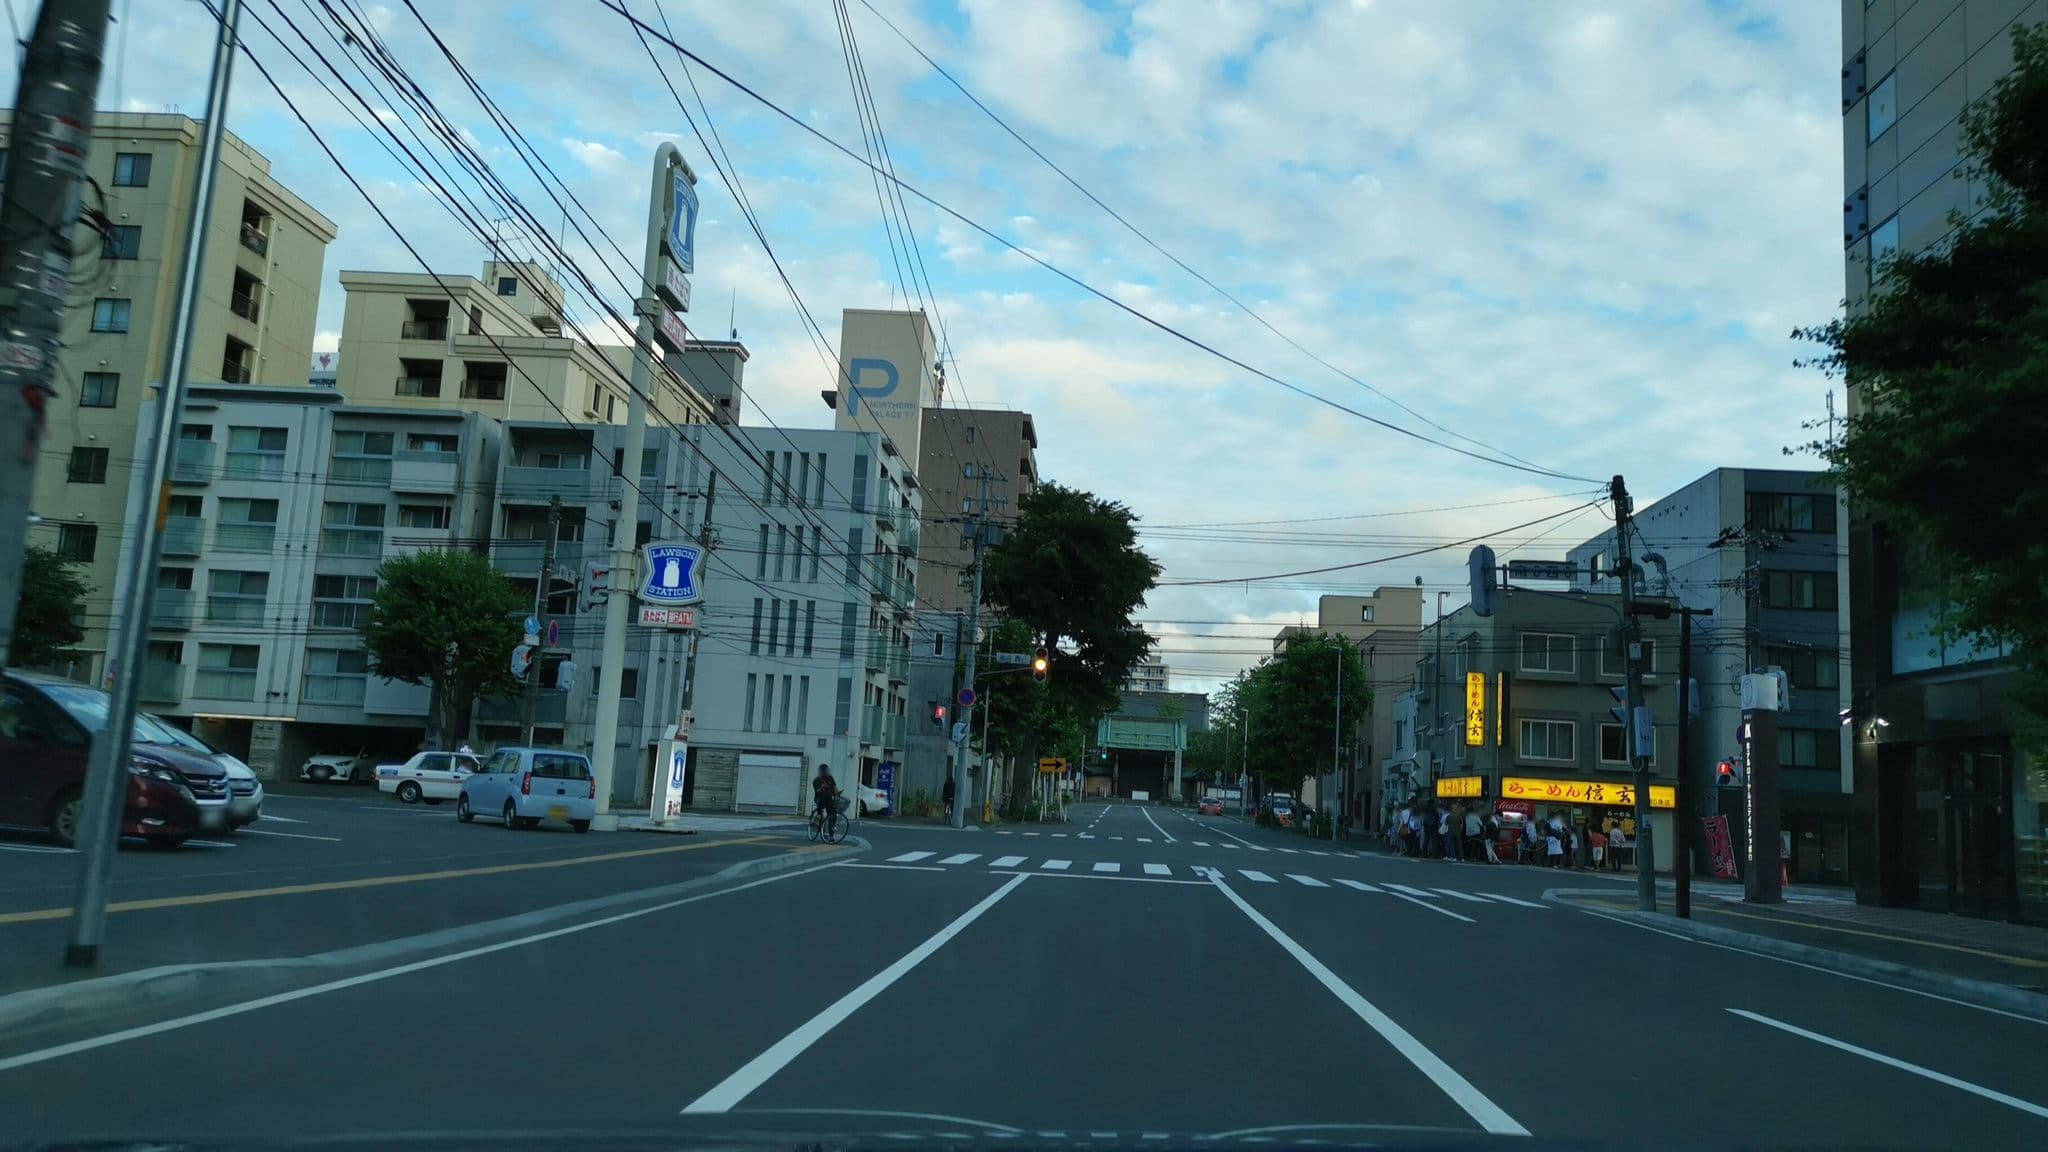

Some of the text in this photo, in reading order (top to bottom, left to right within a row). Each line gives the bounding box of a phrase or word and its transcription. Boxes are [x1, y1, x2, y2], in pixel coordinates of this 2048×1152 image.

[652, 548, 696, 560] LAWSON
[648, 585, 691, 597] STATION
[1508, 781, 1635, 804] らーめん信玄
